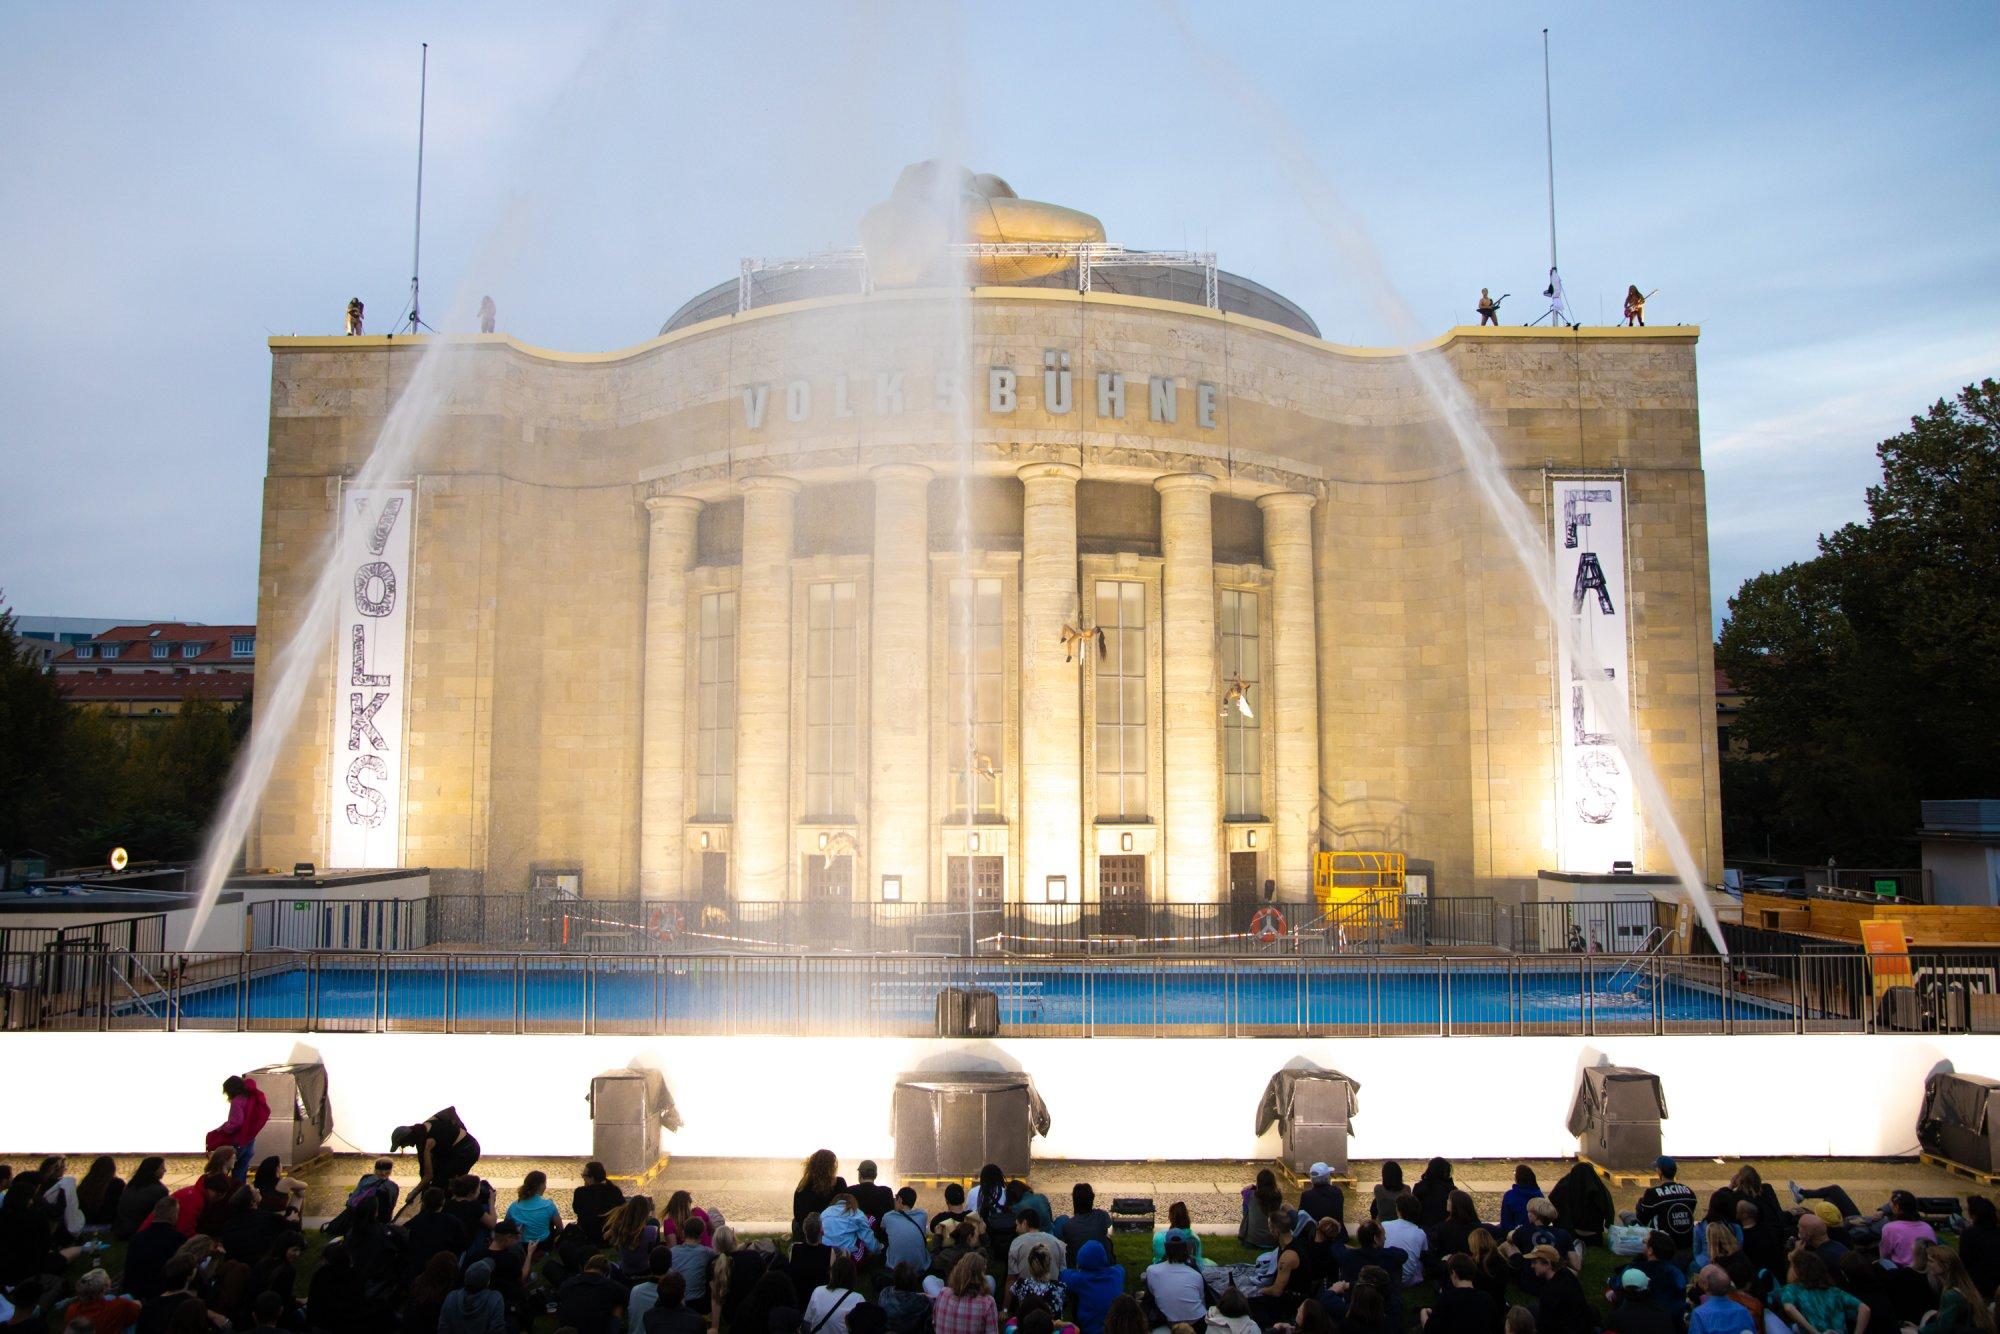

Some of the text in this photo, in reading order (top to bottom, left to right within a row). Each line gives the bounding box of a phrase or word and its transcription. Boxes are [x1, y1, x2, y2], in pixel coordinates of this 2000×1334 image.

[742, 348, 1219, 430] VOLKSBÜHNE
[345, 496, 404, 830] VOLKS
[1563, 488, 1620, 825] FALLS
[1655, 1184, 1691, 1197] RACING
